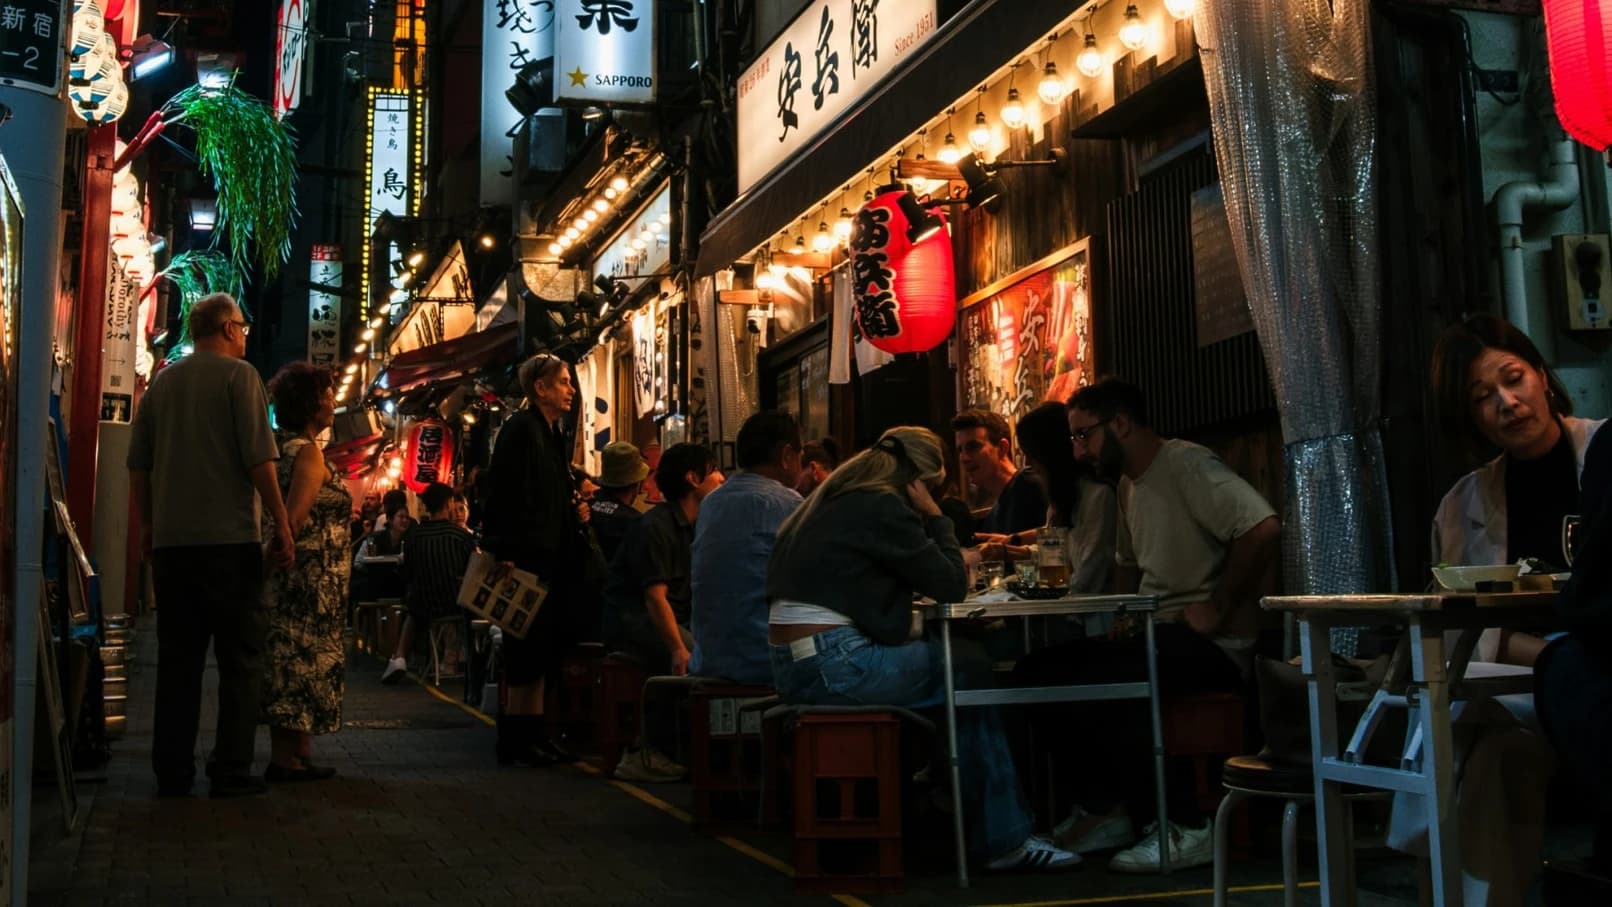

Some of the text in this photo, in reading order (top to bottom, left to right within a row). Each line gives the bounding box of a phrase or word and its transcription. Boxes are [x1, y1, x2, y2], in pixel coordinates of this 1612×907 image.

[1, 5, 53, 39] 新宿
[894, 32, 914, 57] Since
[595, 74, 653, 88] SAPPORO
[376, 167, 407, 201] 鳥
[415, 426, 443, 484] 居酒屋
